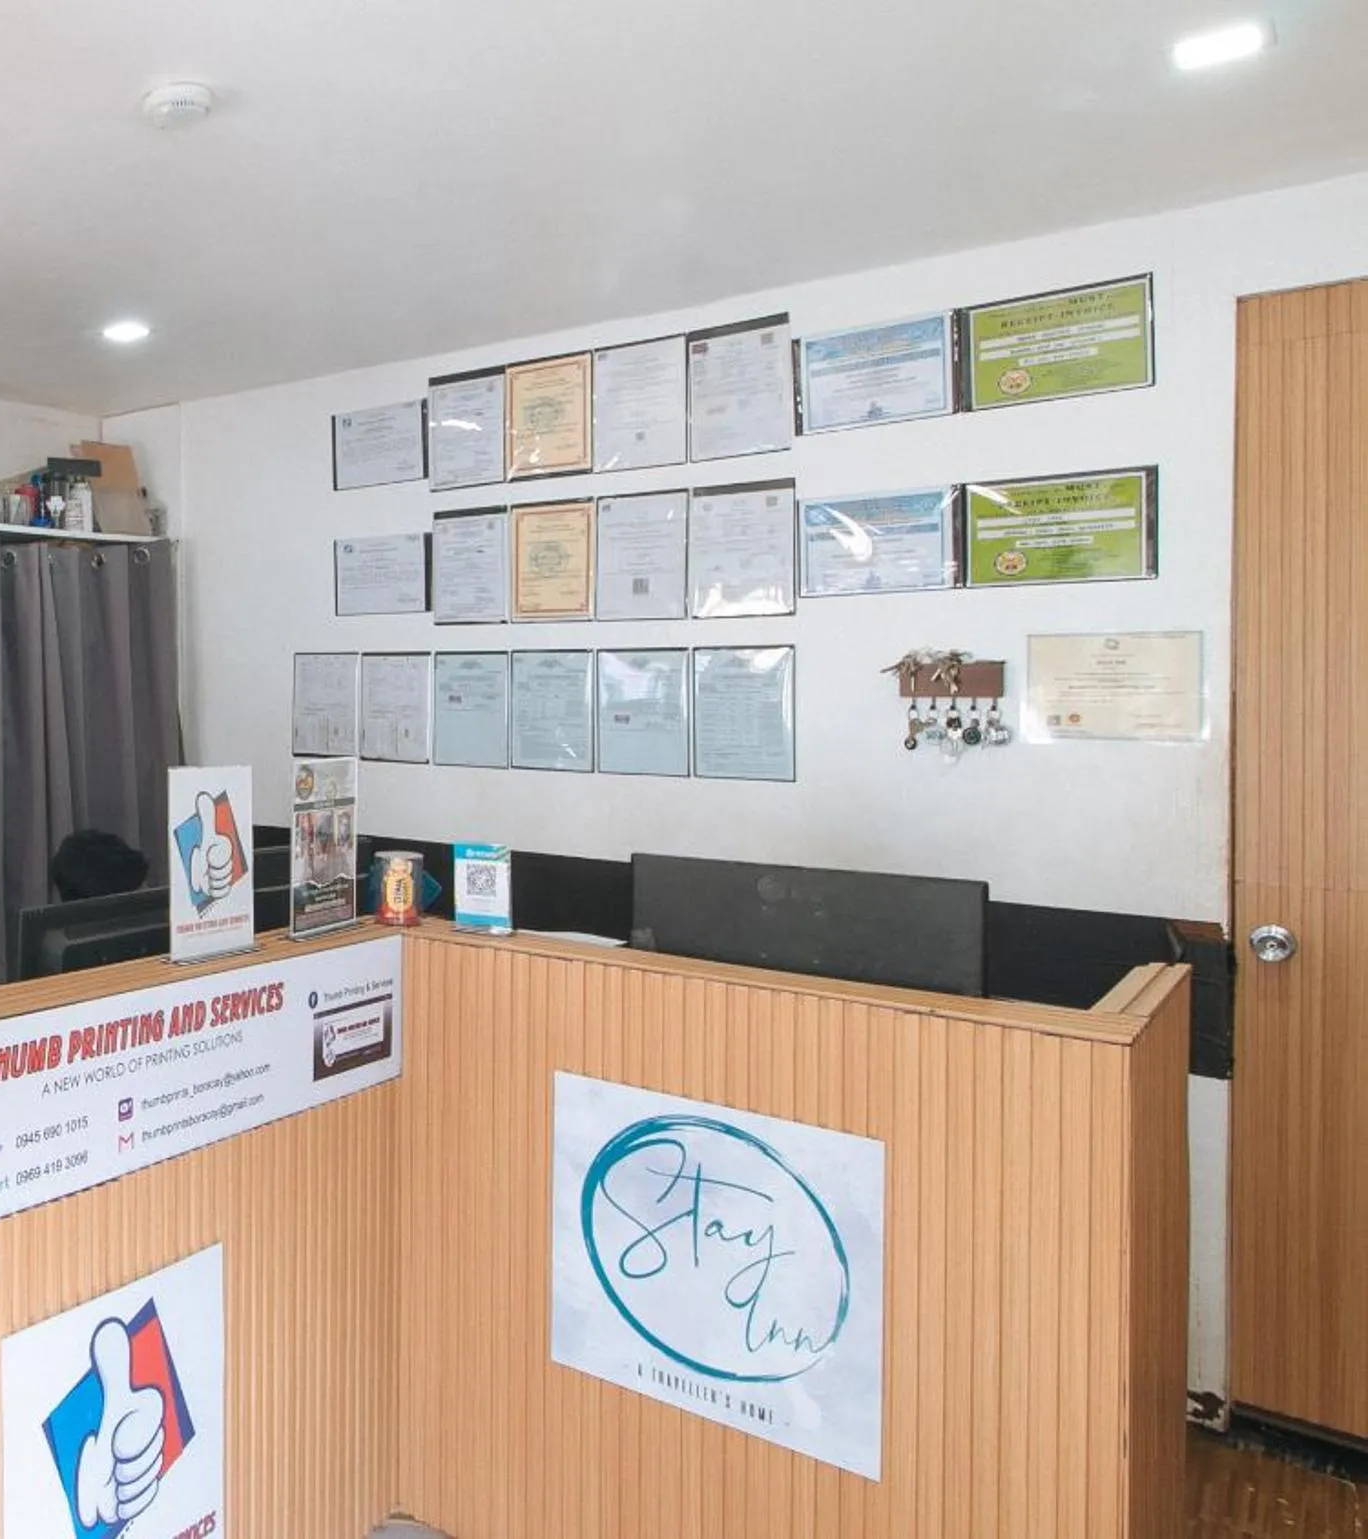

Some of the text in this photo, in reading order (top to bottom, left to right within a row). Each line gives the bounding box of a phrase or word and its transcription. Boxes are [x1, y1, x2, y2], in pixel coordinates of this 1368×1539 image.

[67, 1008, 165, 1064] PRINTING
[168, 999, 207, 1038] AND
[210, 982, 284, 1027] SERVICES
[42, 1030, 244, 1098] A NEW WORLD OF PRINTING SOLUTIONS
[600, 1138, 832, 1353] Stay Inn
[740, 1400, 774, 1425] HOME
